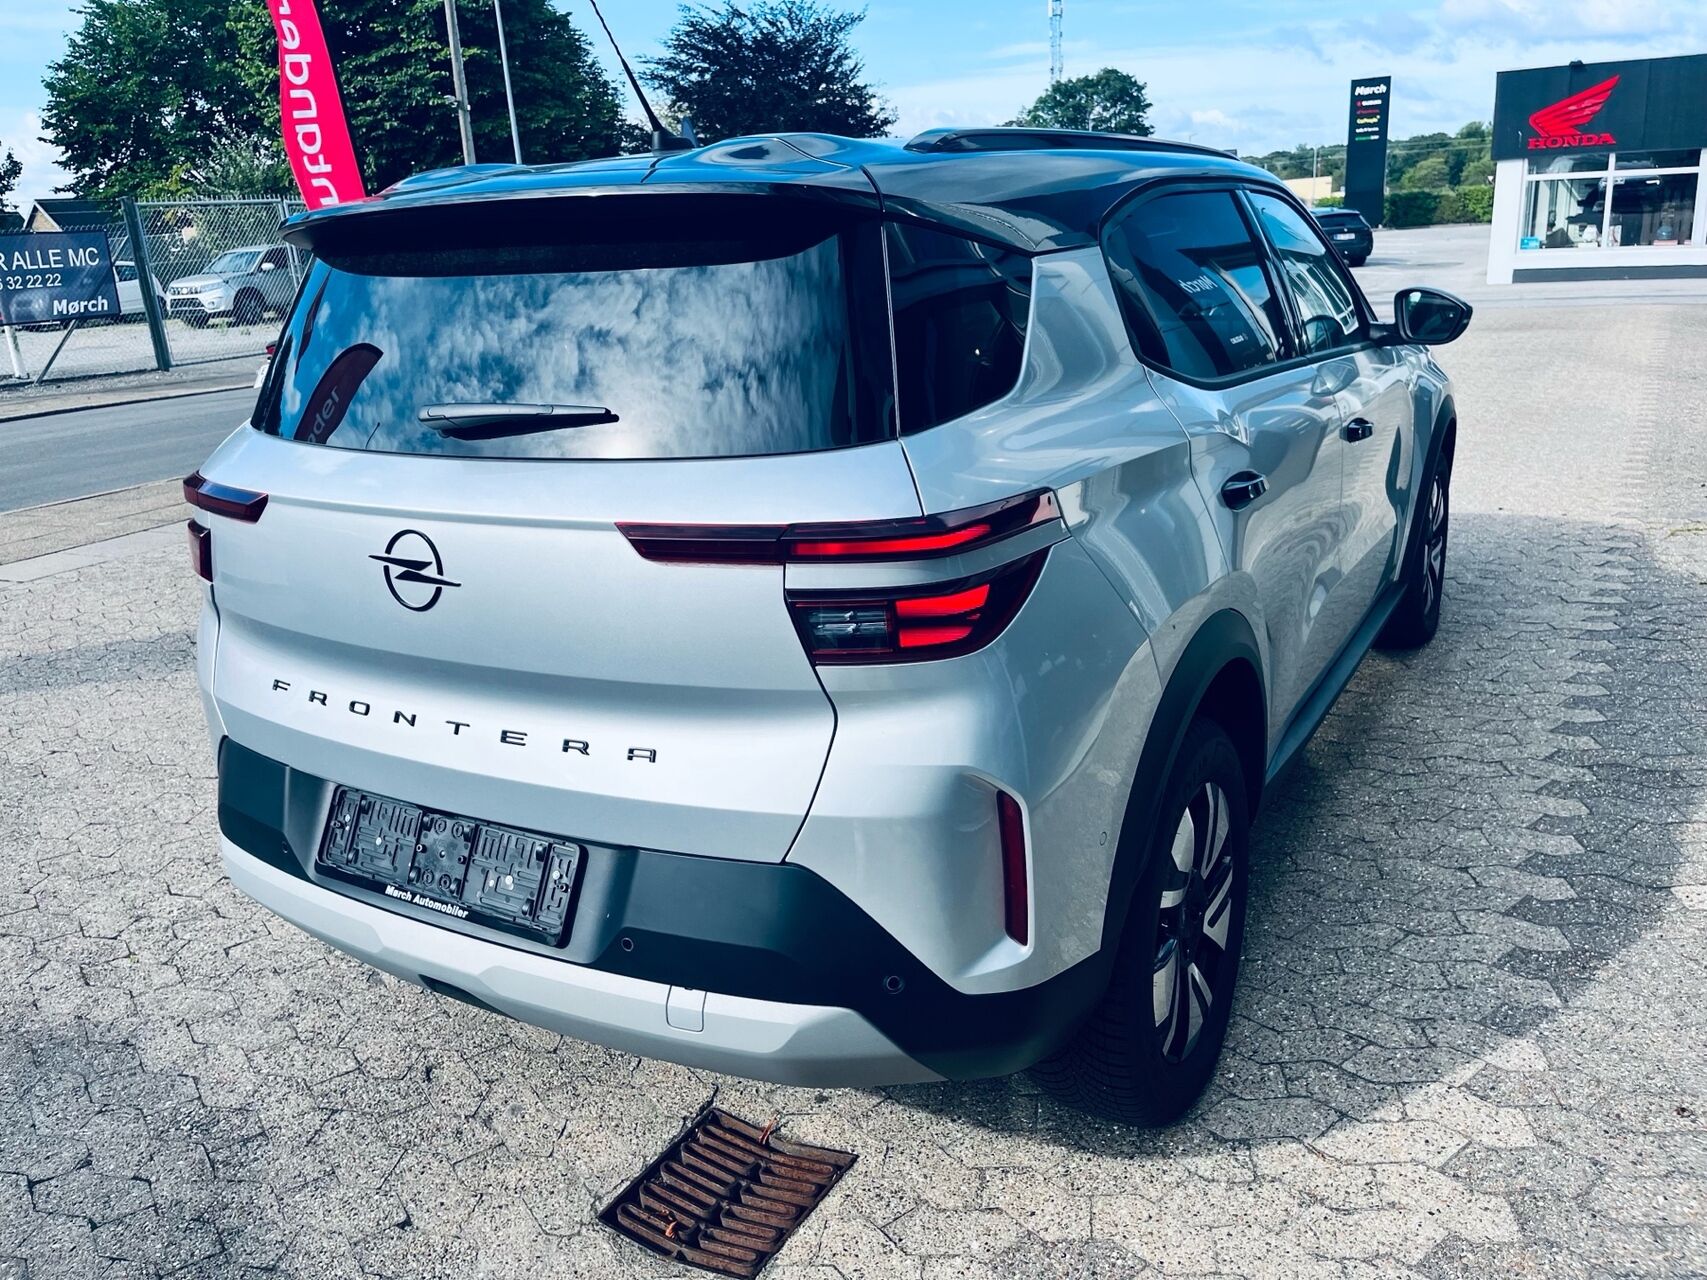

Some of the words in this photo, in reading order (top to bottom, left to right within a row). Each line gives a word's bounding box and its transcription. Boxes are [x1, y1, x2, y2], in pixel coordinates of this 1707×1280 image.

[1527, 133, 1617, 150] HONDA
[11, 249, 64, 271] ALLE
[67, 247, 100, 267] MC
[6, 275, 24, 290] 32
[25, 274, 43, 289] 22
[45, 273, 62, 287] 22
[53, 295, 108, 316] Mørch
[272, 678, 658, 764] FRONTERA
[412, 894, 469, 919] Automobiler
